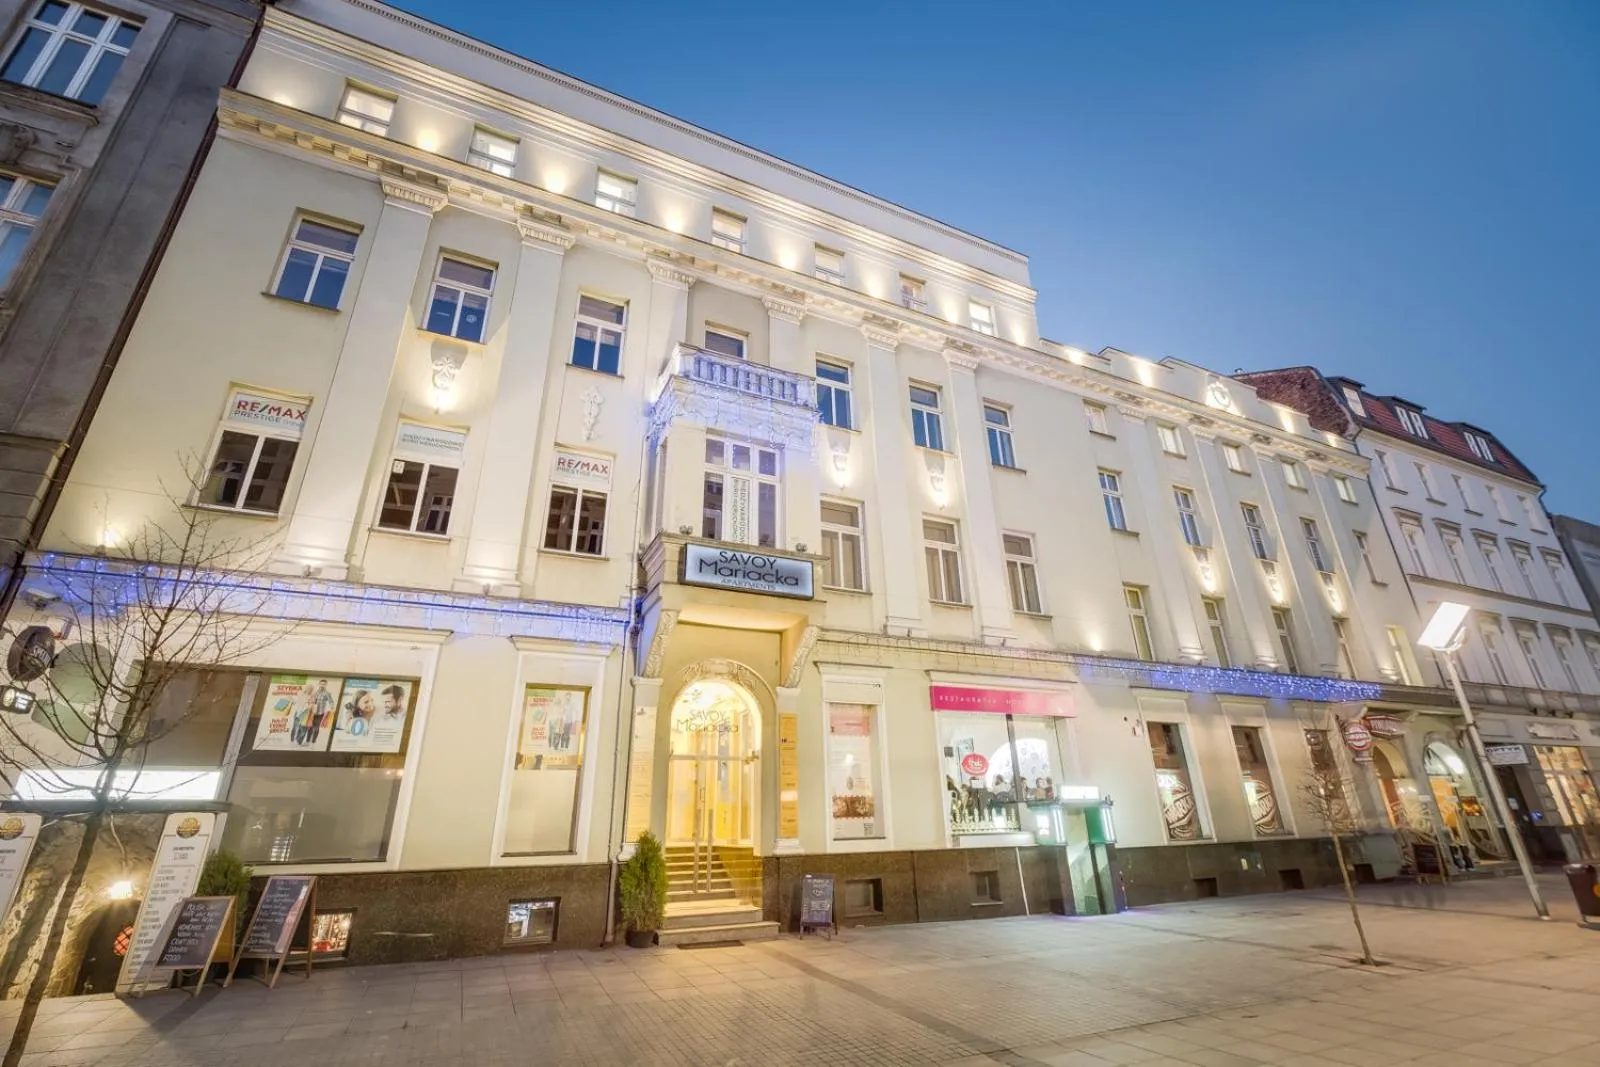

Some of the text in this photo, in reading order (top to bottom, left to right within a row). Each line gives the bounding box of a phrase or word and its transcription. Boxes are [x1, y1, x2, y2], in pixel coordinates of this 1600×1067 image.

[233, 409, 281, 423] PRESTIGE
[237, 399, 307, 421] RE/MAX
[557, 457, 608, 474] RE/MAX
[719, 551, 777, 570] SAVOY
[699, 558, 799, 586] Mariacka
[720, 578, 777, 591] APARTMENTS
[689, 709, 727, 722] SAVOY
[676, 718, 740, 733] Mariacka
